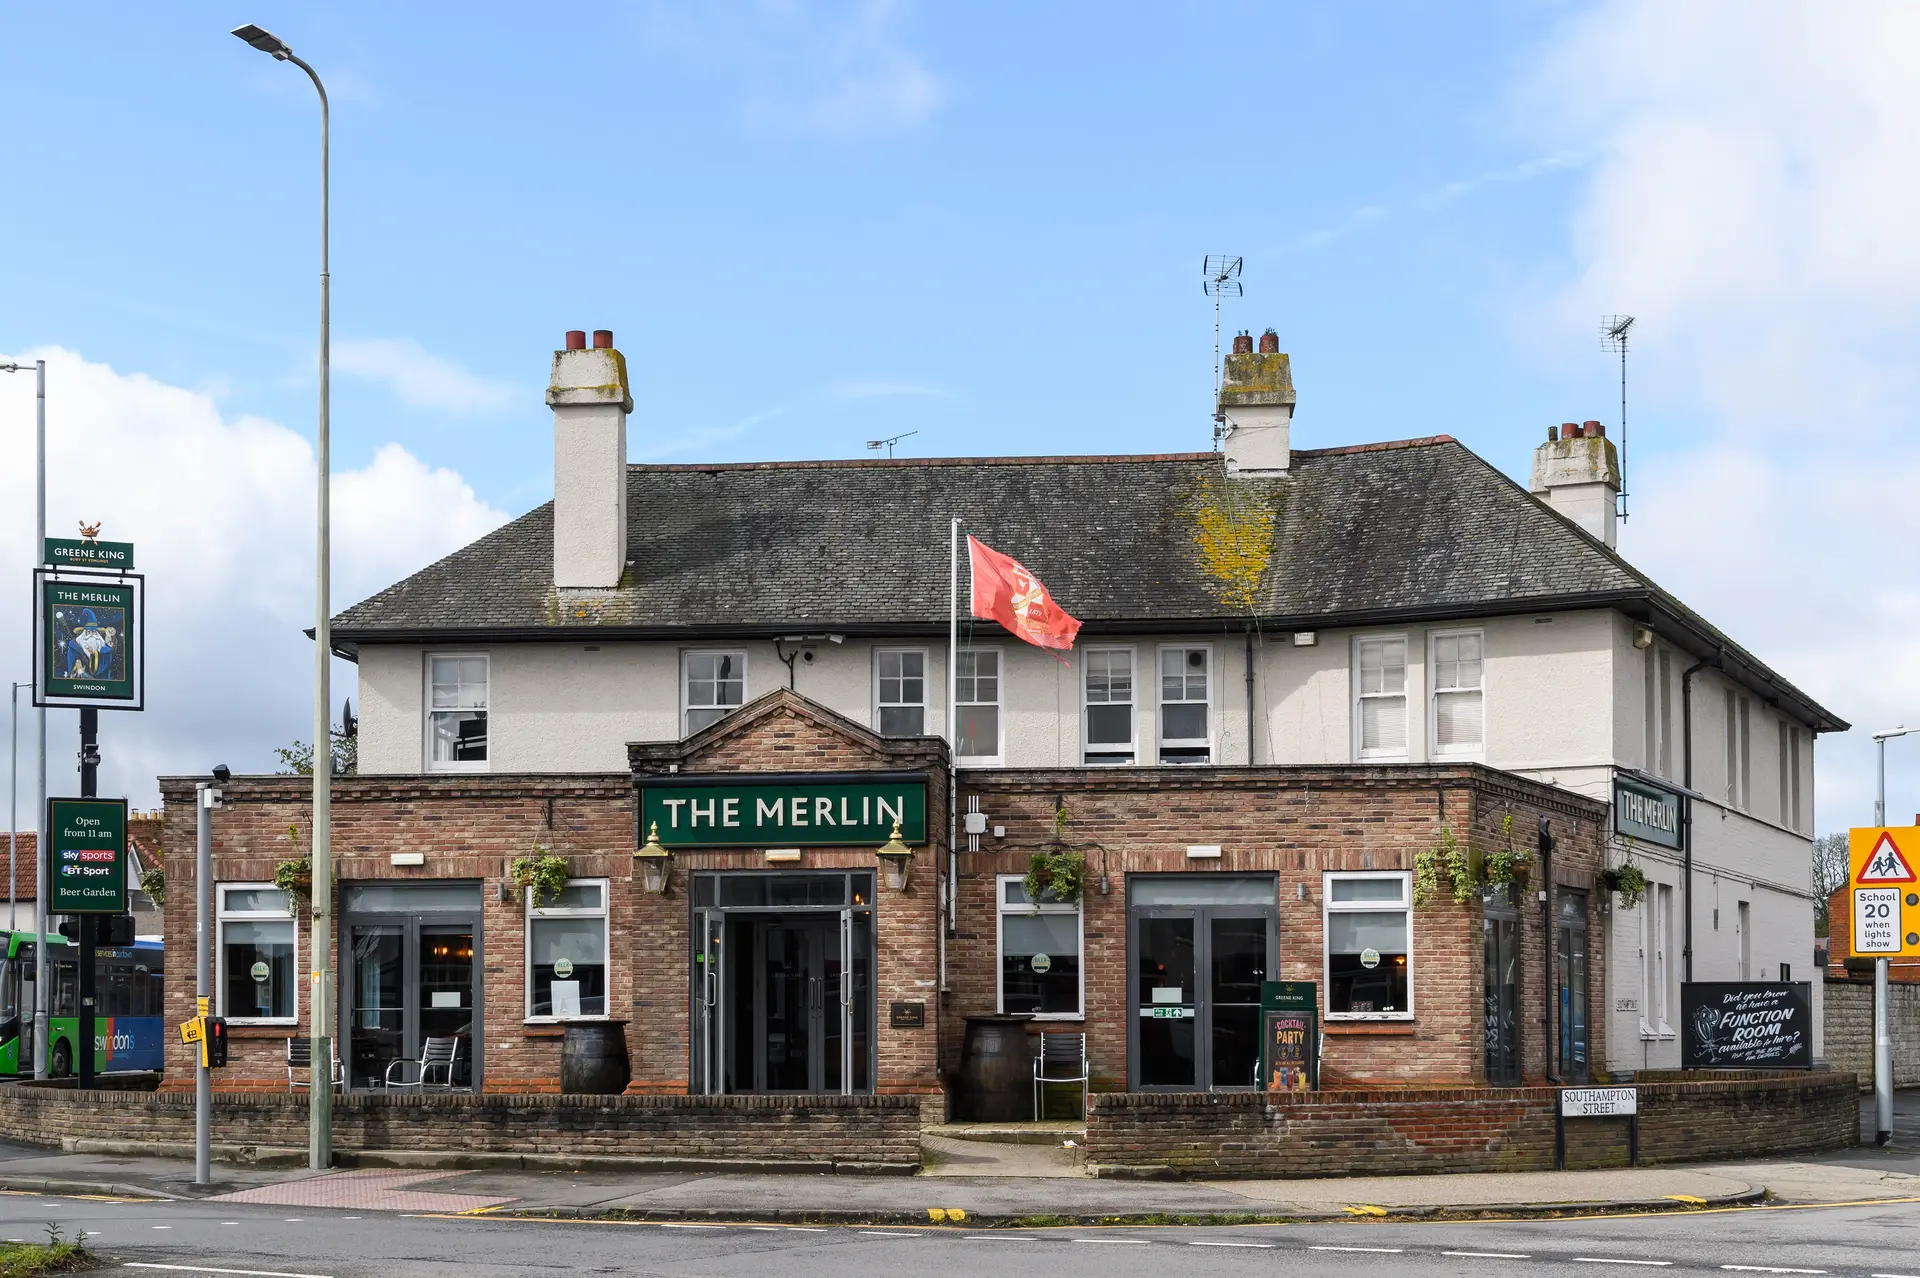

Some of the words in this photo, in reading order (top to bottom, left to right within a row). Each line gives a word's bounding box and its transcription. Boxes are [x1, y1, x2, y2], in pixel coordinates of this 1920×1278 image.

[54, 548, 95, 558] GREENE
[98, 550, 125, 560] KING
[57, 591, 79, 601] THE
[81, 592, 120, 603] MERLIN
[73, 683, 106, 691] SWINDON
[662, 797, 740, 829] THE
[756, 795, 904, 828] MERLIN
[1623, 789, 1643, 824] THE
[1643, 797, 1677, 834] MERLIN
[75, 816, 100, 827] Open
[64, 828, 86, 837] from
[88, 829, 96, 838] 11
[63, 850, 79, 861] sky
[82, 851, 113, 861] sports
[67, 867, 82, 875] BT
[83, 866, 110, 877] Sport
[60, 887, 81, 896] Beer
[82, 887, 116, 897] Garden
[1859, 892, 1896, 902] School
[1864, 903, 1890, 918] 20
[1865, 921, 1890, 929] when
[1864, 930, 1892, 940] lights
[1723, 991, 1743, 1004] Did
[1742, 992, 1762, 1004] you
[1763, 990, 1790, 999] know
[1748, 1000, 1770, 1009] have
[1719, 1007, 1795, 1030] FUNCTION
[1276, 1019, 1305, 1031] COCKTAIL
[1276, 1030, 1305, 1045] PARTY
[1732, 1022, 1782, 1042] ROOM
[94, 1028, 135, 1051] swindon's
[1718, 1038, 1763, 1054] available
[1772, 1030, 1801, 1044] hire?
[1564, 1089, 1635, 1102] SOUTHAMPTON
[1582, 1102, 1616, 1115] STREET
